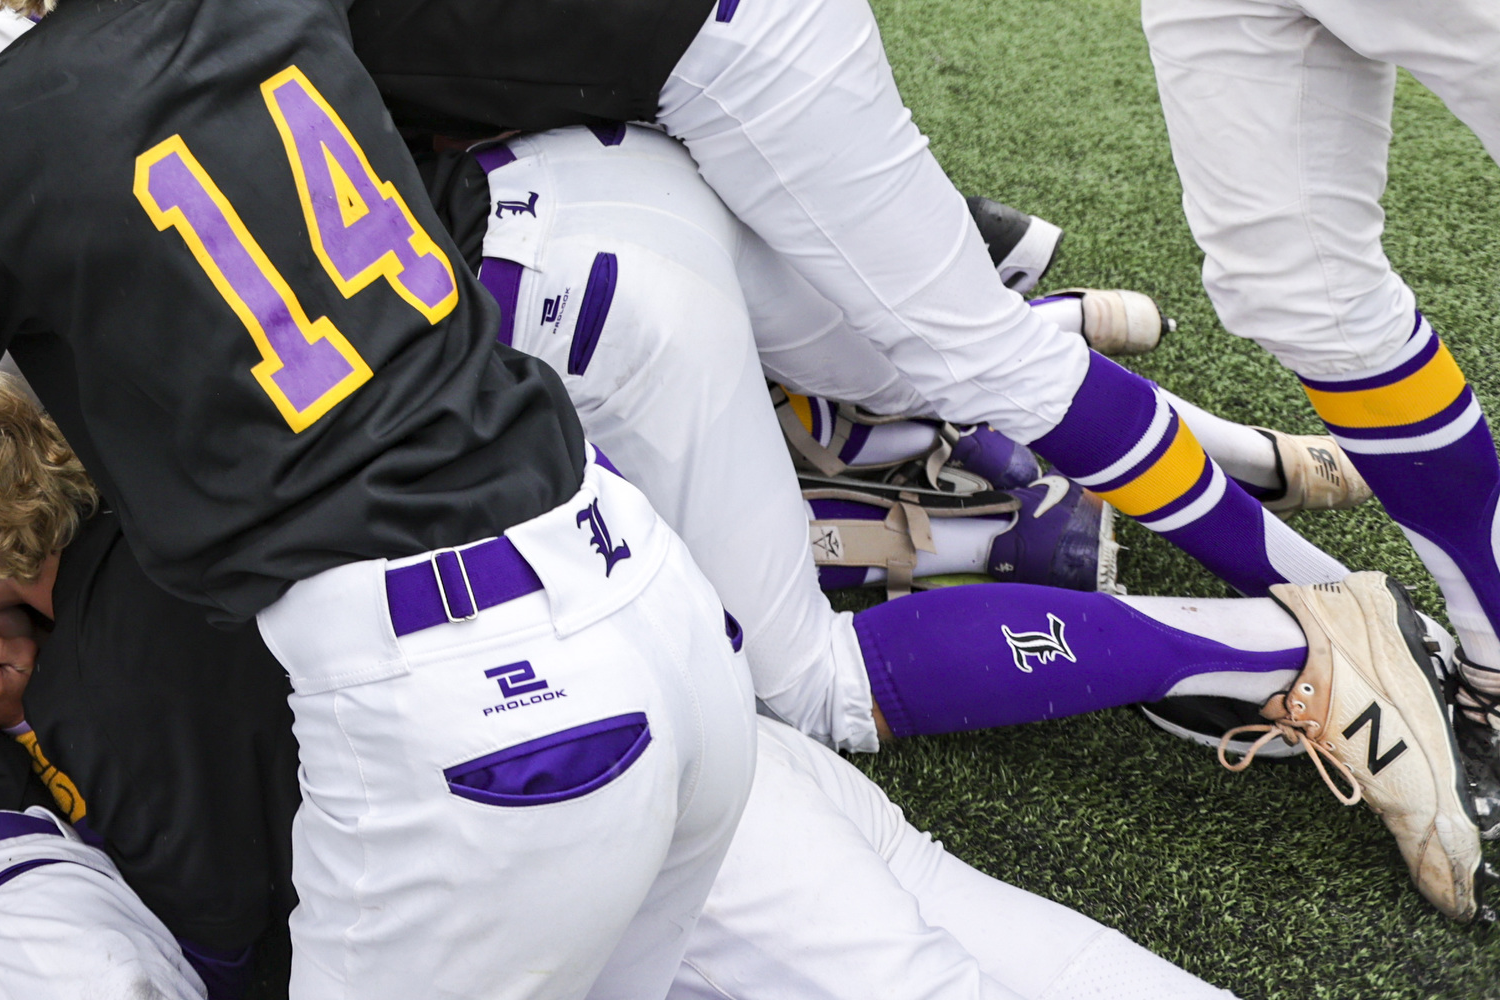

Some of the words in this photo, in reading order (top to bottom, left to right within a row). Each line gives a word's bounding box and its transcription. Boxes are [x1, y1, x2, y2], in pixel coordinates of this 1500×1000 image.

[133, 64, 459, 434] 14
[552, 287, 571, 335] PROLOOK
[576, 497, 632, 578] L
[1000, 612, 1078, 673] L
[482, 688, 568, 717] PROLOOK
[1341, 700, 1408, 776] N
